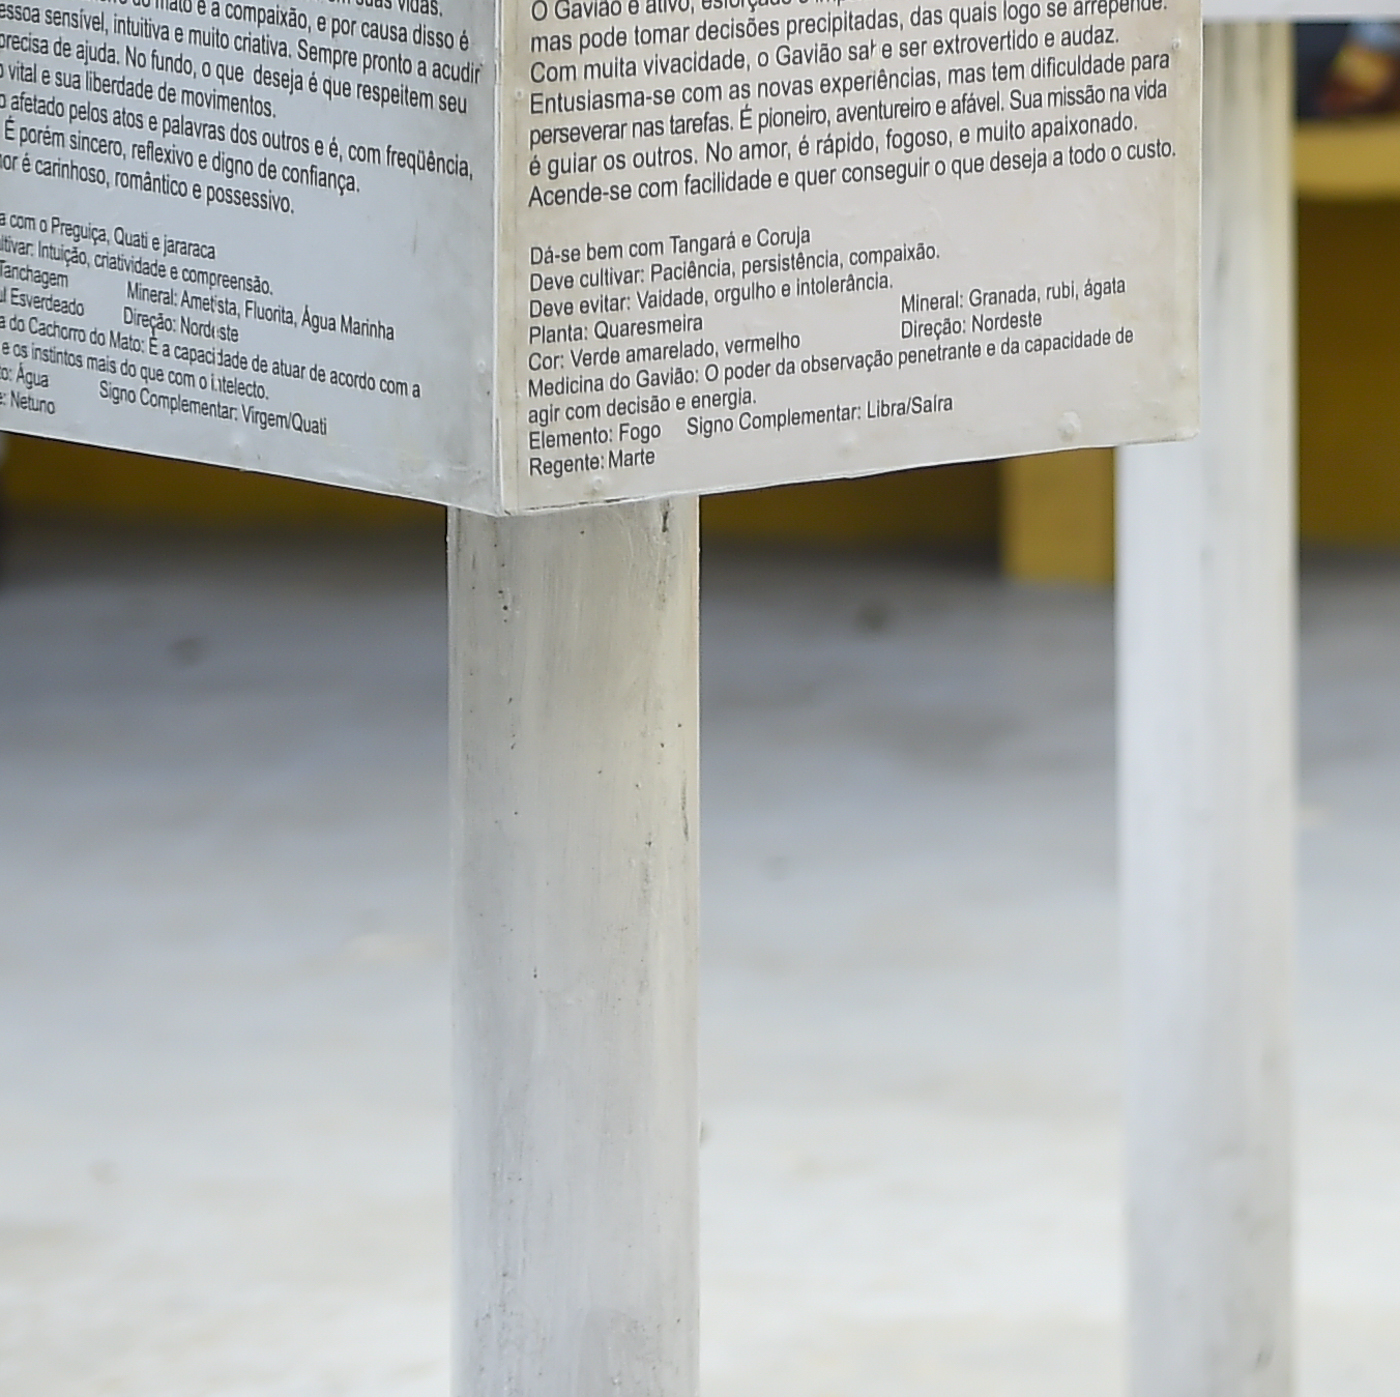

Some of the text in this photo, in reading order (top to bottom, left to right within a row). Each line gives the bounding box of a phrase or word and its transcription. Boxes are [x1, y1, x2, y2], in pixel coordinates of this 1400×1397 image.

[4, 113, 360, 197] É porém sincero, reflexivo e digno de confiança.
[530, 225, 811, 266] Dá-se bem com Tangará e Coruja
[529, 241, 940, 293] Deve cultivar: Paciência, persistência, compaixão.
[901, 276, 1126, 315] Mineral: Granada, rubi, ágata
[528, 312, 703, 346] Planta: Quaresmeira
